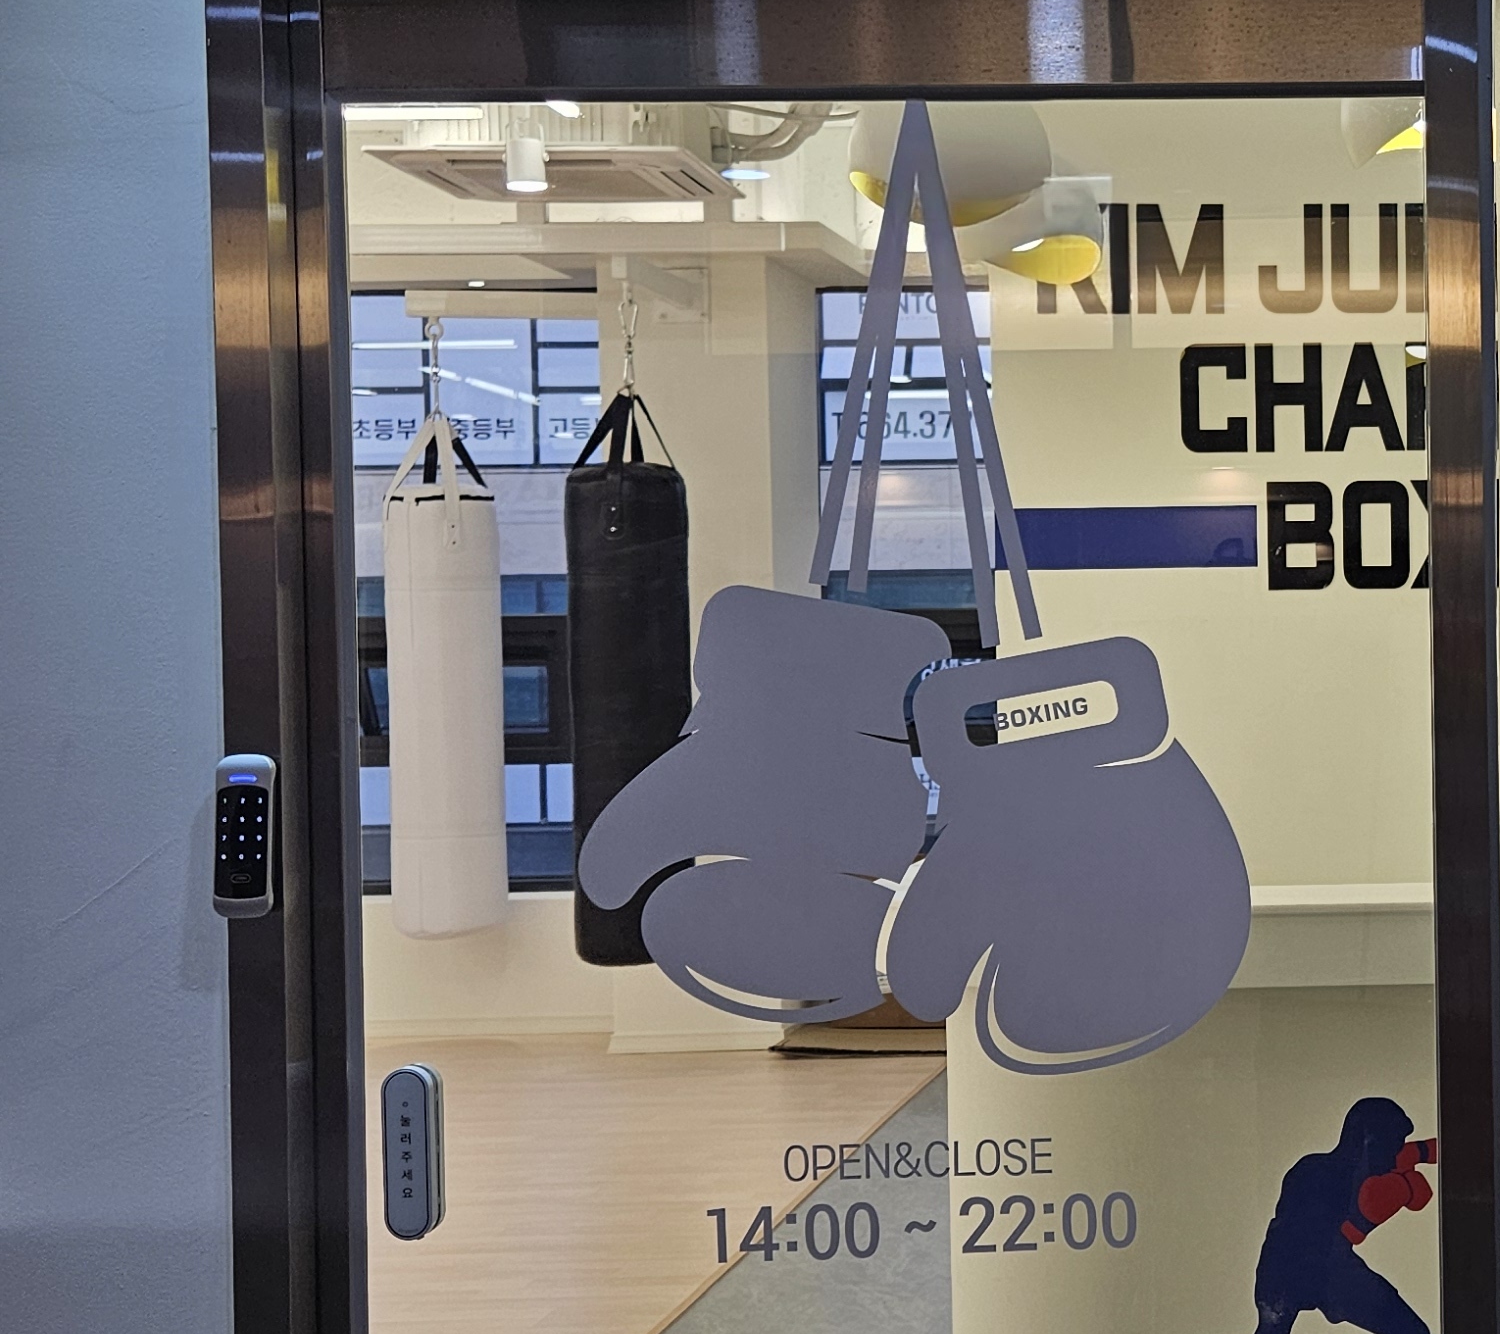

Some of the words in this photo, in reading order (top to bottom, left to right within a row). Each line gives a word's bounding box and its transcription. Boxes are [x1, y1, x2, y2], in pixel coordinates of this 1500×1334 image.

[352, 418, 417, 441] 초등부
[548, 417, 600, 440] 고등
[993, 697, 1089, 732] BOXING
[783, 1138, 1053, 1182] OPEN&CLOSE
[706, 1201, 880, 1264] 14:00
[959, 1191, 1137, 1255] 22:00
